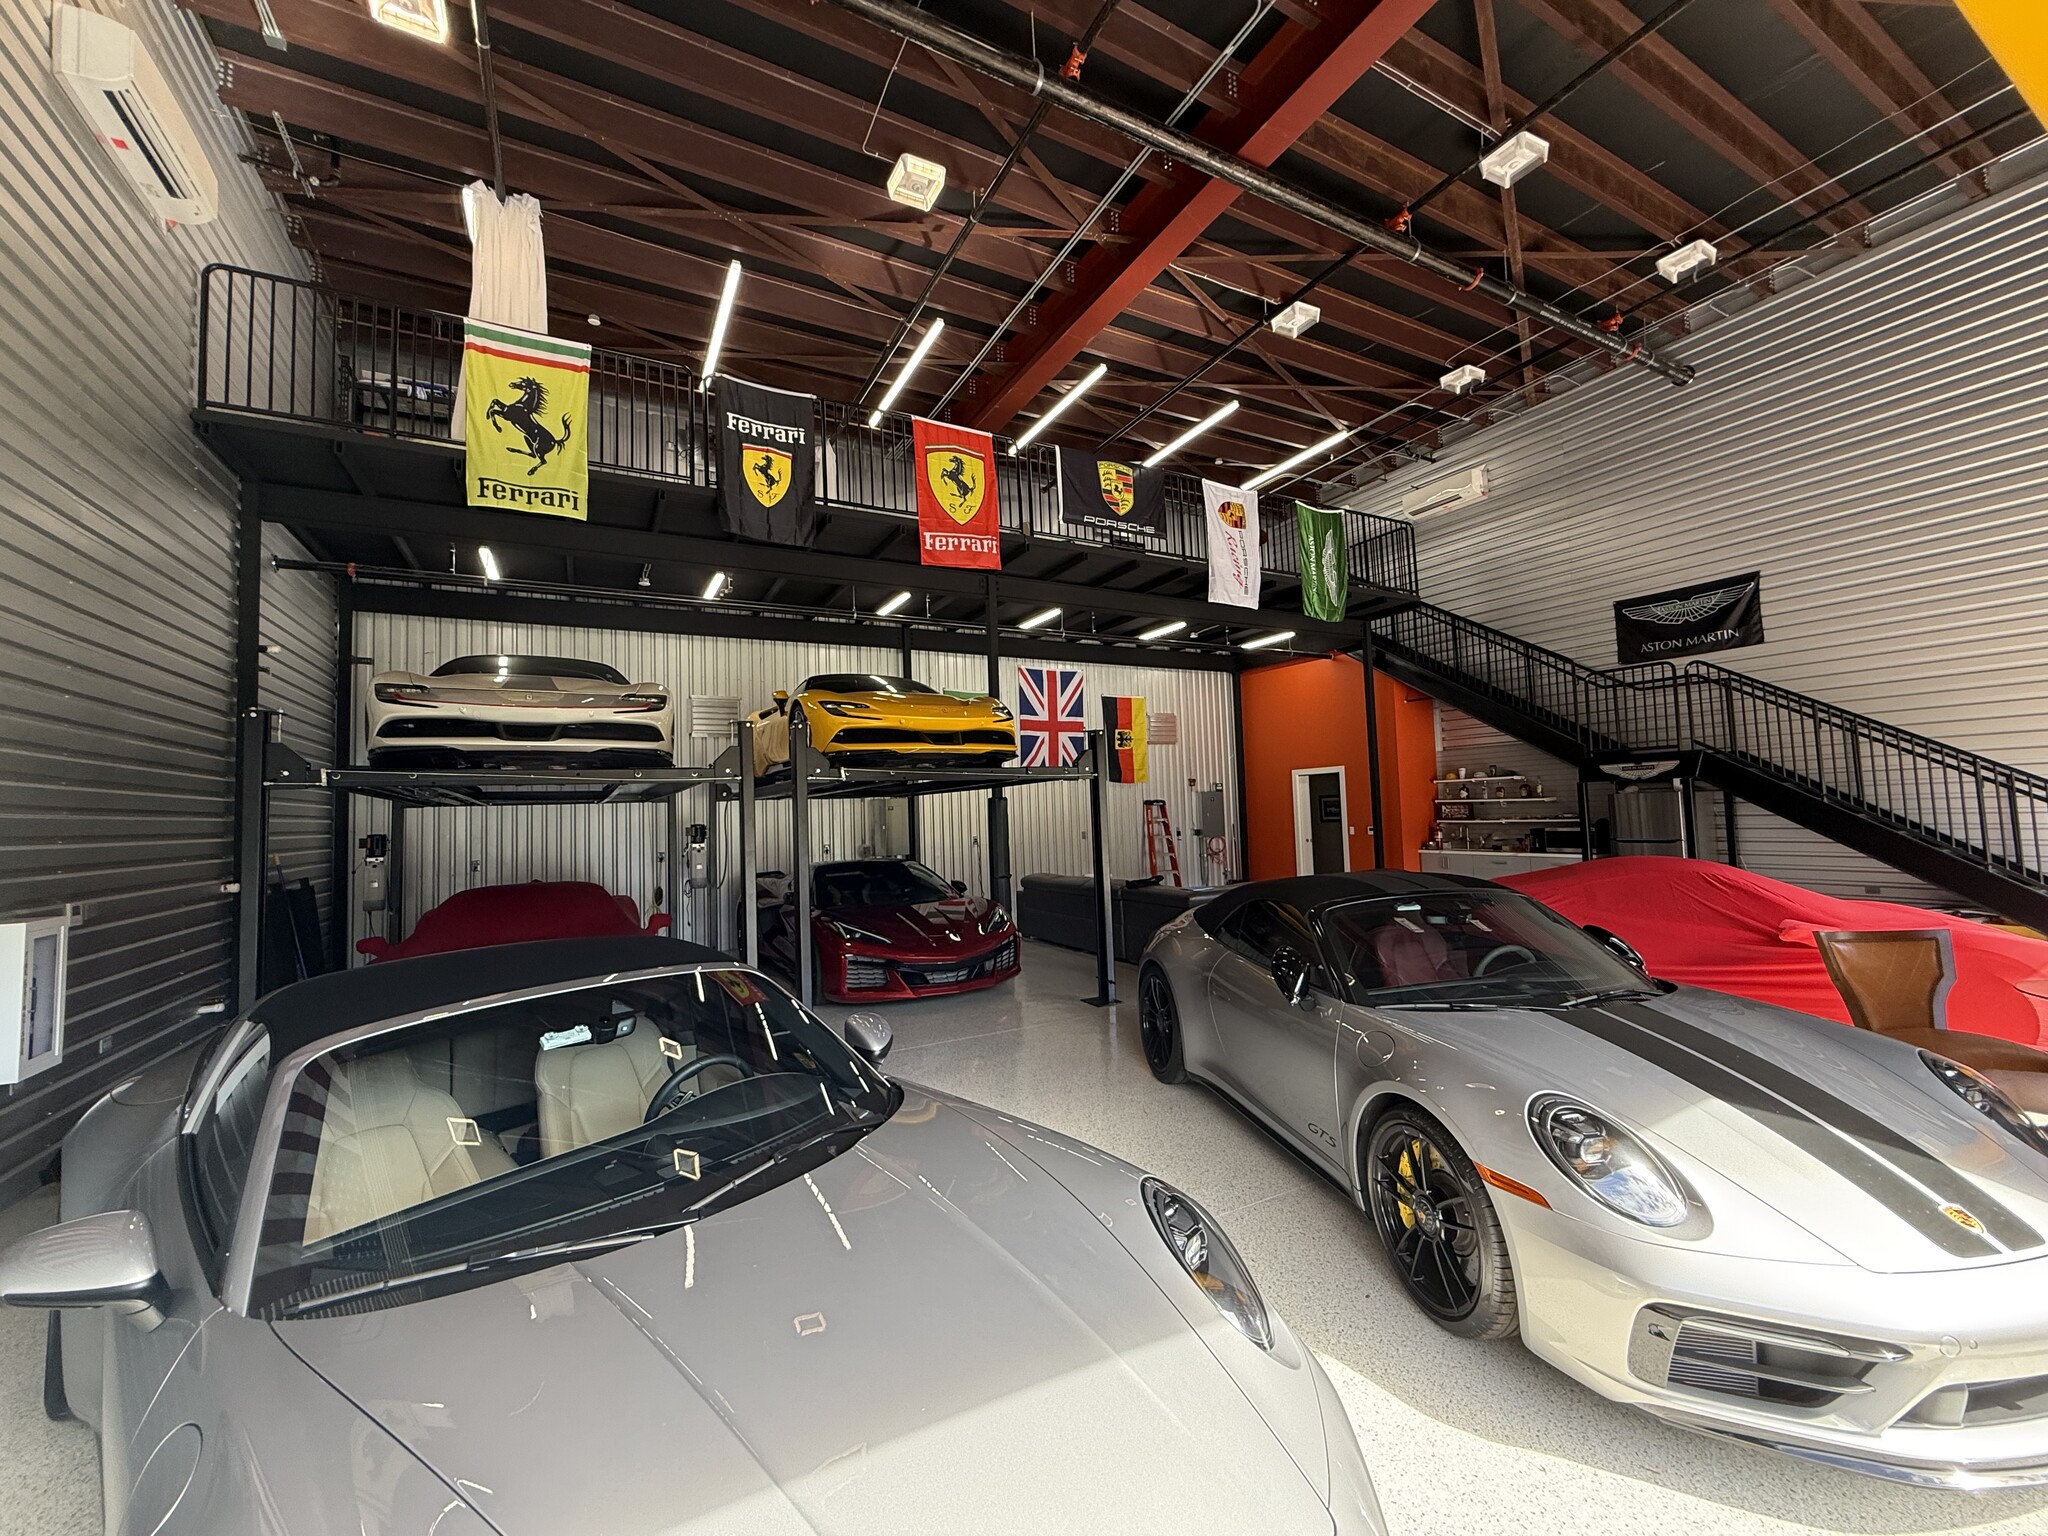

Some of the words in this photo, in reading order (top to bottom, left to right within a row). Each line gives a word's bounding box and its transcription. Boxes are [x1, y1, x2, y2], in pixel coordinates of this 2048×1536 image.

[726, 412, 806, 445] Ferrari
[1098, 462, 1132, 474] PORSCHE
[477, 477, 580, 512] Ferrari
[949, 503, 957, 514] S
[1083, 515, 1155, 534] PORSCHE
[923, 531, 998, 554] Ferrari
[1308, 535, 1316, 562] ASTON
[1238, 530, 1249, 595] PORSCHE
[1660, 604, 1683, 613] ASTON
[1684, 597, 1711, 609] MARTIN
[1640, 638, 1683, 653] ASTON
[1685, 628, 1740, 647] MARTIN
[1307, 1122, 1337, 1148] GTS
